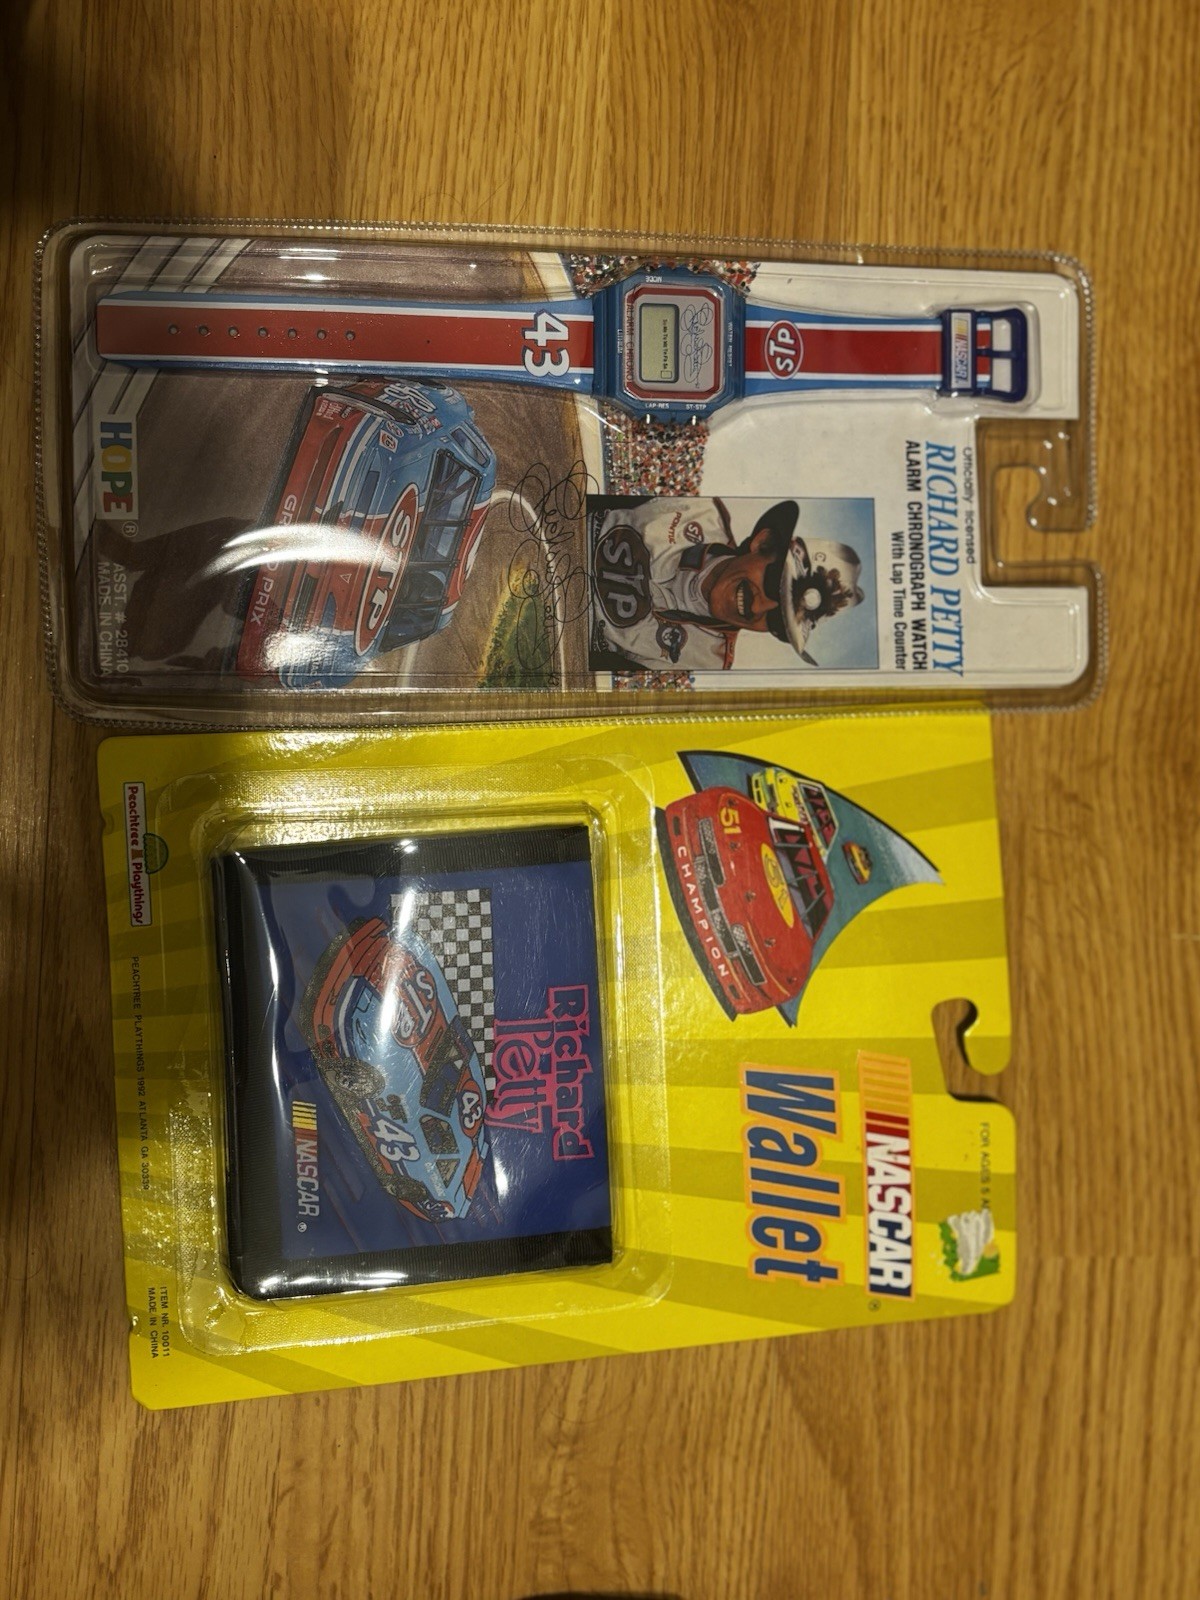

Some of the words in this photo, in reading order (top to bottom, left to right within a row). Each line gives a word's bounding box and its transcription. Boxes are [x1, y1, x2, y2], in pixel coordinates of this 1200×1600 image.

[626, 304, 634, 336] ALARM
[522, 310, 570, 378] 43
[626, 342, 634, 381] CHRONO
[769, 328, 796, 372] STP
[955, 339, 968, 379] NASCAR
[100, 422, 133, 513] HOPE
[905, 440, 922, 492] ALARM
[925, 440, 960, 576] RICHARD
[891, 531, 904, 560] With
[908, 501, 926, 611] CHRONOGRAPH
[964, 510, 976, 564] licensed
[97, 562, 112, 604] MADE
[112, 562, 126, 606] ASST.
[366, 509, 412, 631] STP
[602, 539, 644, 619] STP
[890, 563, 905, 584] Lap
[100, 612, 112, 626] IN
[114, 612, 127, 622] #
[250, 576, 274, 626] PRIX
[892, 588, 906, 618] Time
[115, 630, 128, 673] 28410
[894, 622, 908, 670] Counter
[911, 618, 928, 670] WATCH
[930, 585, 964, 677] PETTY
[100, 630, 113, 677] CHINA
[128, 786, 140, 846] Peachtree
[720, 807, 742, 834] 51
[130, 862, 144, 924] Playthings
[678, 846, 729, 976] CHAMPION
[131, 956, 142, 1010] PEACHTREE
[394, 971, 434, 1039] STP
[134, 1014, 144, 1072] PLAYTHINGS
[137, 1076, 146, 1096] 1992
[486, 1018, 554, 1133] Petty
[550, 987, 592, 1159] Richard
[138, 1101, 148, 1141] ATLANTA
[460, 1092, 483, 1129] 43
[140, 1146, 149, 1158] GA
[374, 1119, 420, 1162] 43
[980, 1122, 990, 1148] FOR
[141, 1162, 150, 1190] 30339
[296, 1138, 320, 1216] NASCAR
[745, 1070, 841, 1283] Wallet
[980, 1152, 990, 1184] AGES
[865, 1132, 912, 1290] NASCAR
[148, 1288, 156, 1313] MADE
[160, 1286, 168, 1309] ITEM
[150, 1317, 157, 1326] IN
[161, 1313, 170, 1328] NR.
[150, 1330, 159, 1358] CHINA
[162, 1330, 170, 1357] 10011
